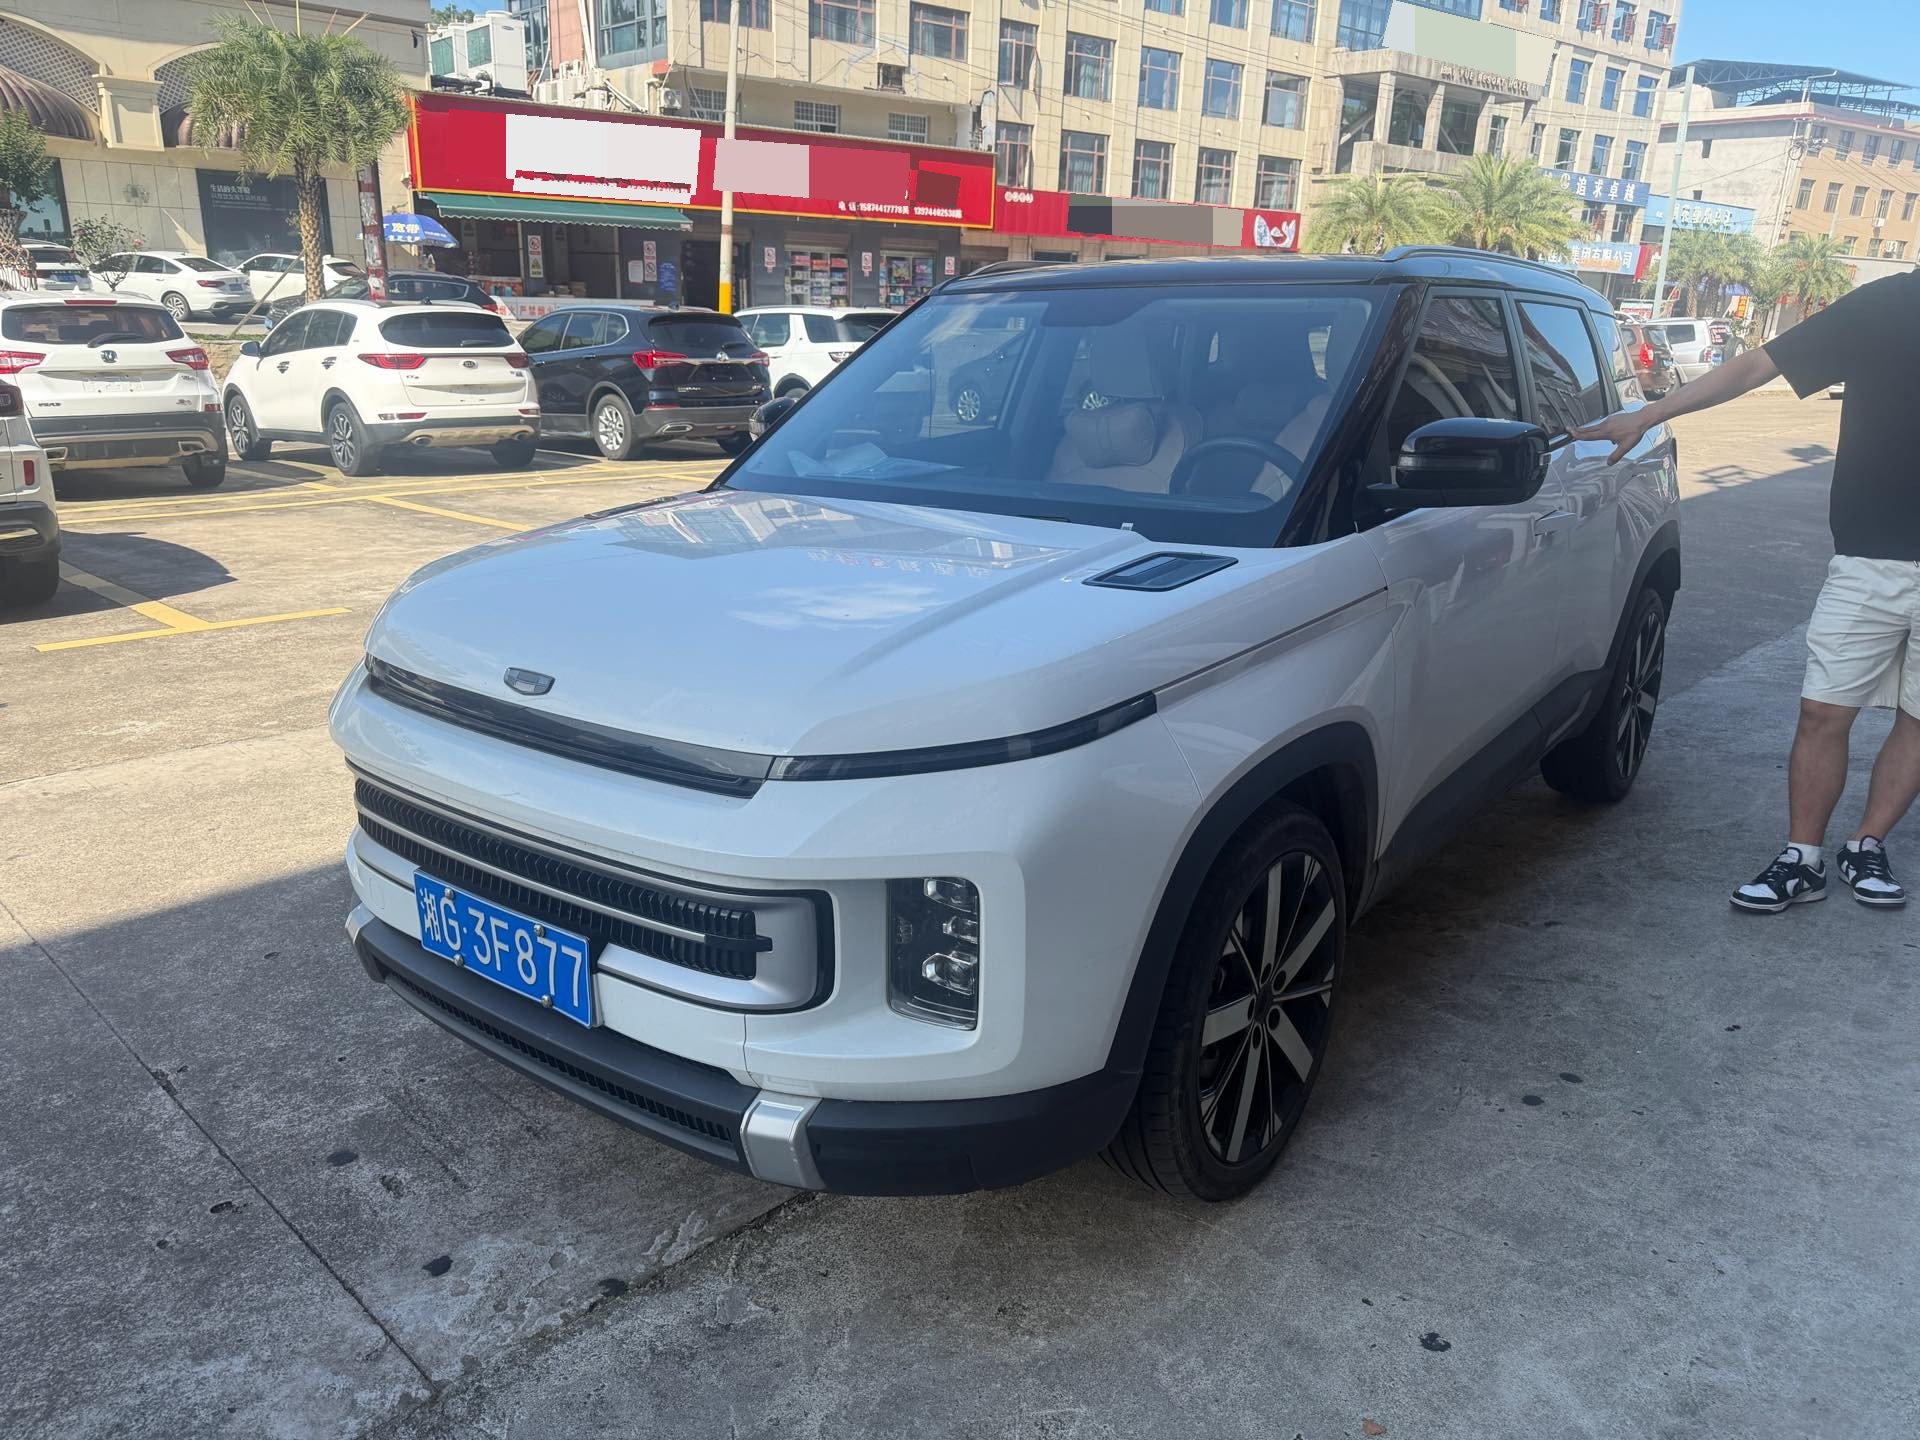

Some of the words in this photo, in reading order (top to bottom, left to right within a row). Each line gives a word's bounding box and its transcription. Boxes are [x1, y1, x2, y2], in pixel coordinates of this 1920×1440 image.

[1478, 72, 1505, 87] RESORT
[1508, 78, 1529, 92] HOTEL
[1576, 176, 1635, 203] 追求卓越
[419, 888, 582, 1008] 湘G·3F877
